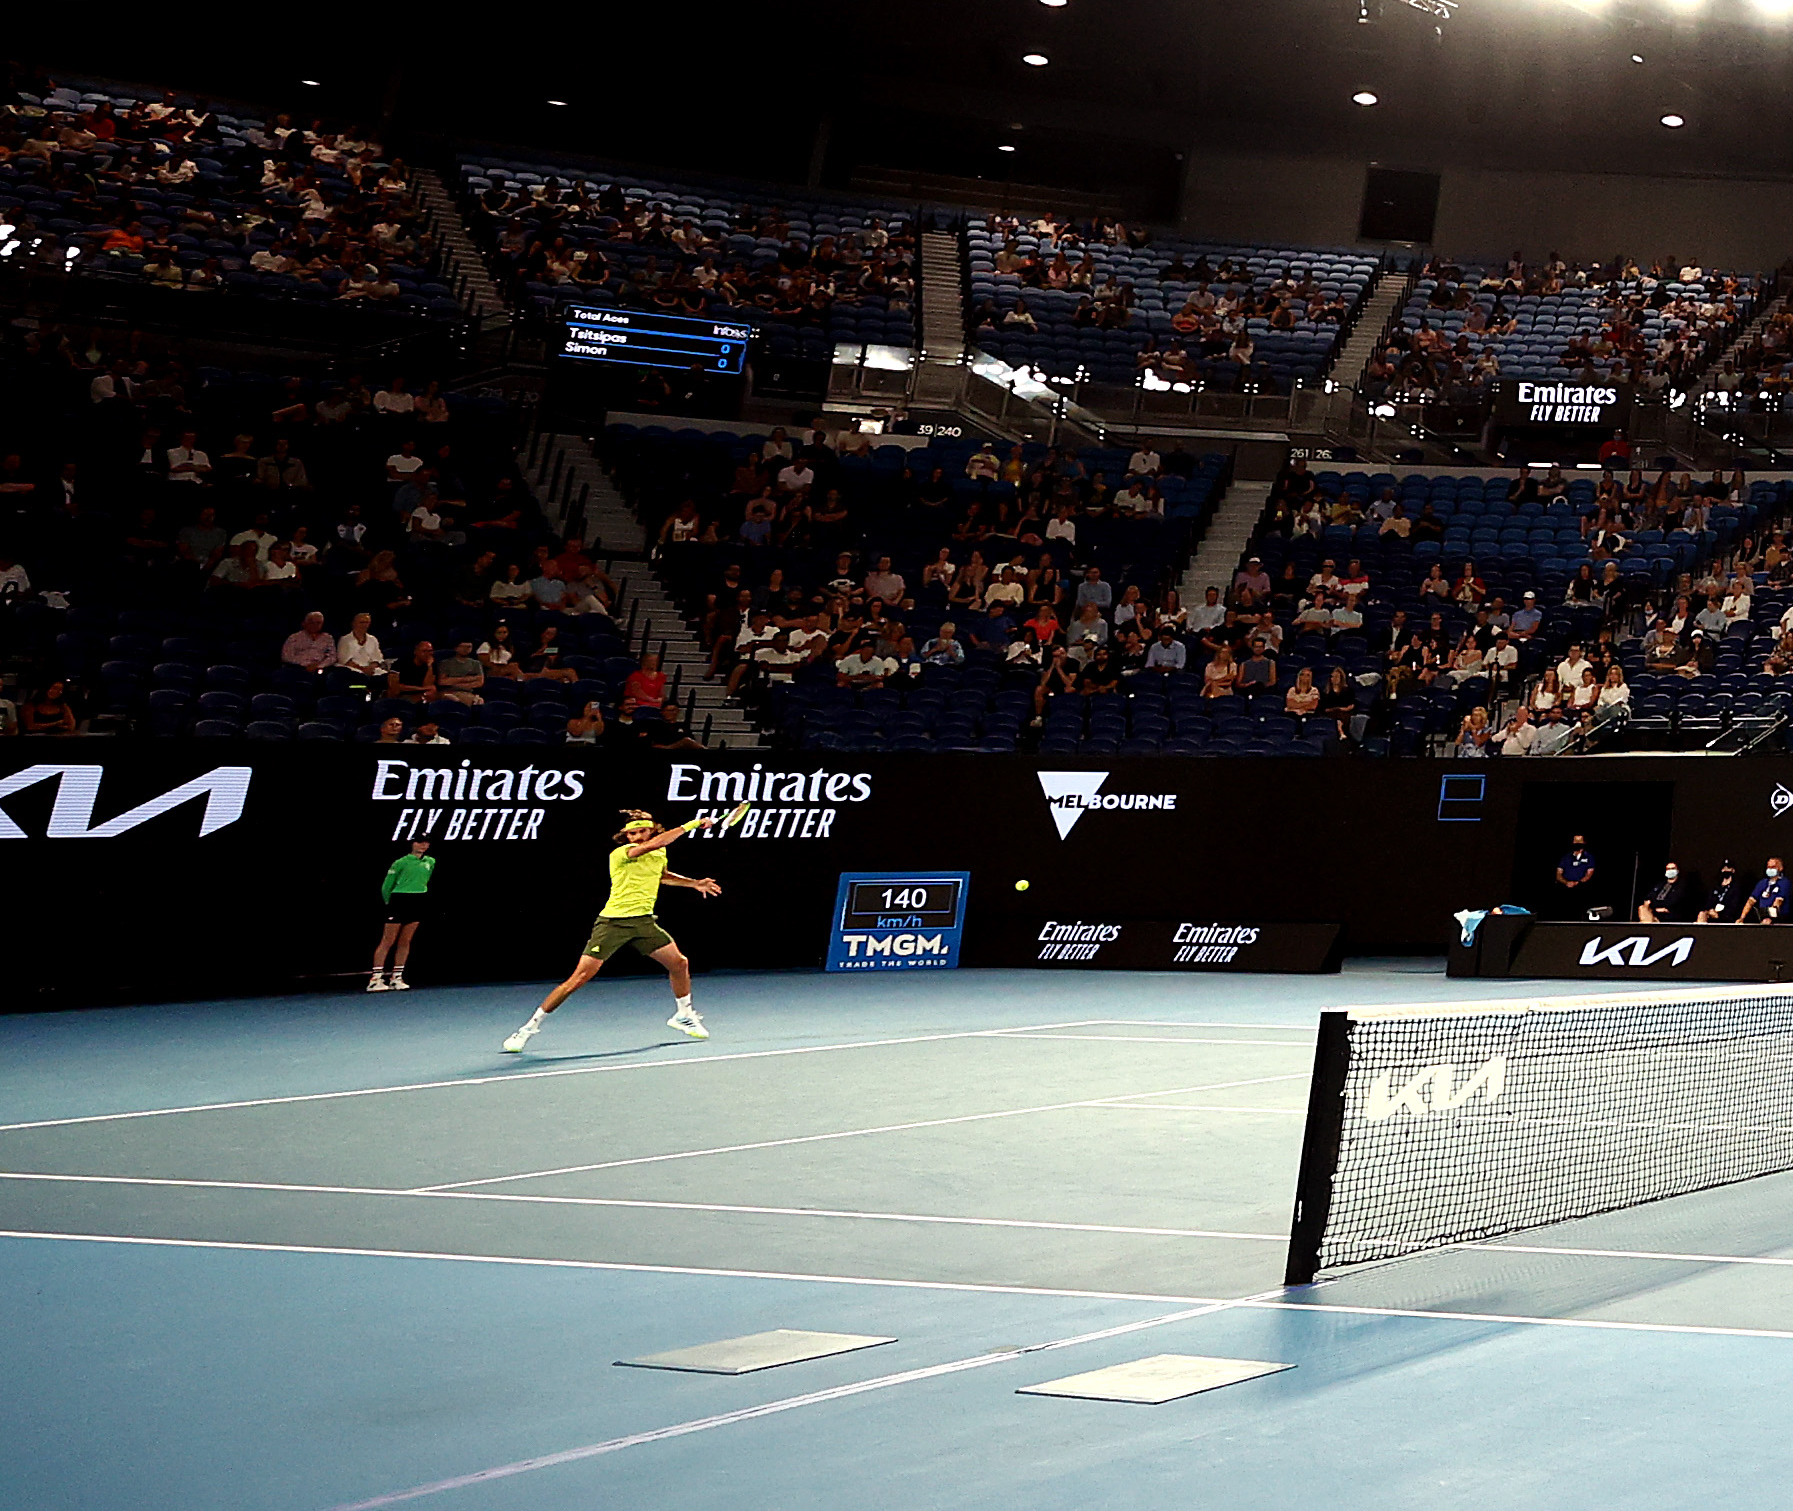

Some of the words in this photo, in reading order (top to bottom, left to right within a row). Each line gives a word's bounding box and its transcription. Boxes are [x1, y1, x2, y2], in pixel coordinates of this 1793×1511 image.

[573, 309, 602, 321] Total
[602, 313, 629, 325] Aces
[569, 327, 628, 344] Tsitsipas
[565, 341, 607, 356] Simon
[1518, 382, 1617, 404] Emirates
[1530, 404, 1553, 422] FLY
[1554, 405, 1601, 423] BETTER
[937, 426, 962, 437] 240
[1290, 448, 1309, 458] 261
[371, 759, 584, 801] Emirates
[667, 763, 872, 802] Emirates
[1047, 793, 1177, 810] MELBOURNE
[392, 808, 441, 842] FLY
[447, 808, 545, 841] BETTER
[740, 808, 836, 838] BETTER
[881, 888, 927, 909] 140
[876, 915, 922, 928] km/h
[1039, 921, 1122, 943] Emirates
[1173, 923, 1260, 945] Emirates
[1038, 942, 1057, 960] FLY
[1060, 942, 1101, 961] BETTER
[1174, 944, 1195, 963] FLY
[1198, 944, 1239, 964] BETTER
[1579, 936, 1694, 967] KIA
